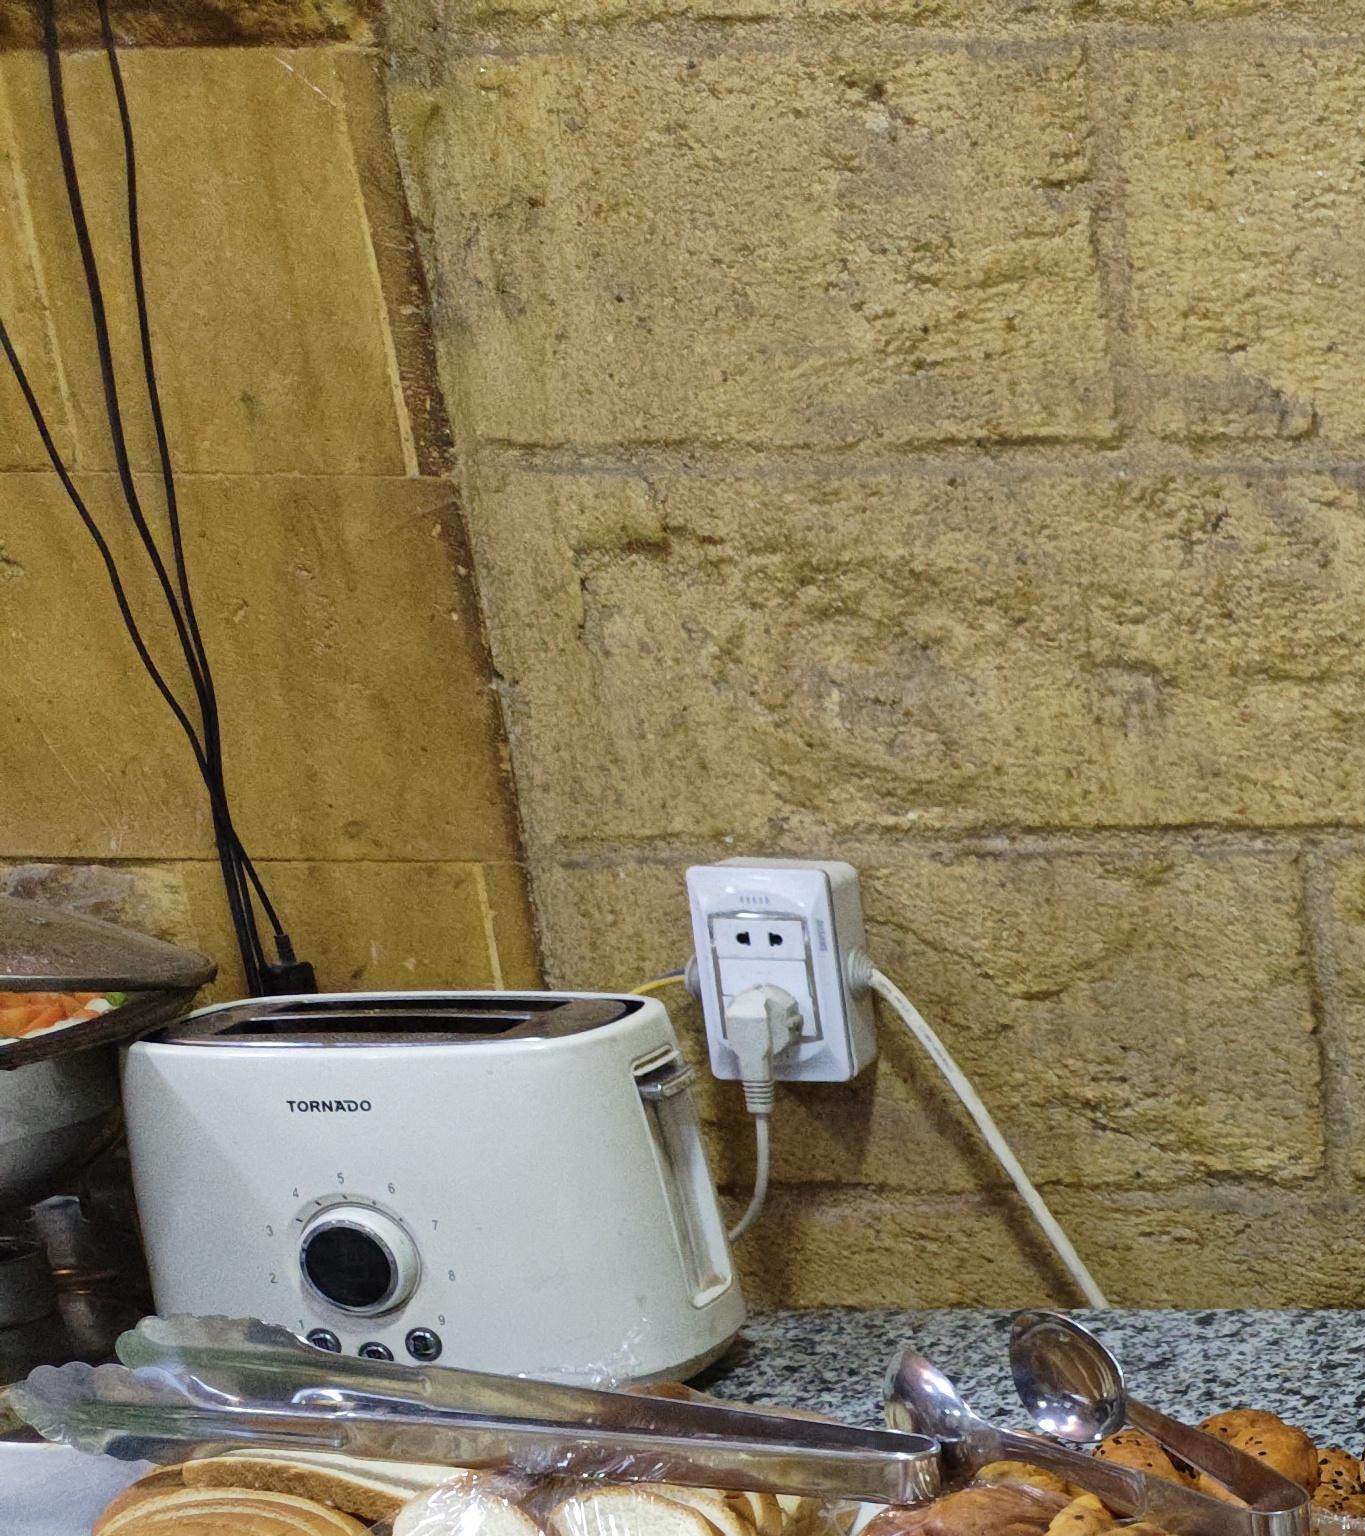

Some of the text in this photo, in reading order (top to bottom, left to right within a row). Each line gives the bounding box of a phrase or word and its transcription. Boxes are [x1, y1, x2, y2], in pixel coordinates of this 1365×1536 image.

[286, 1099, 372, 1113] TORNADO
[337, 1172, 345, 1185] 5
[292, 1187, 299, 1199] 4
[387, 1182, 396, 1195] 6
[266, 1224, 274, 1237] 3
[431, 1219, 439, 1231] 7
[269, 1272, 279, 1284] 2
[448, 1270, 456, 1282] 8
[298, 1319, 305, 1330] 1
[438, 1314, 446, 1326] 9
